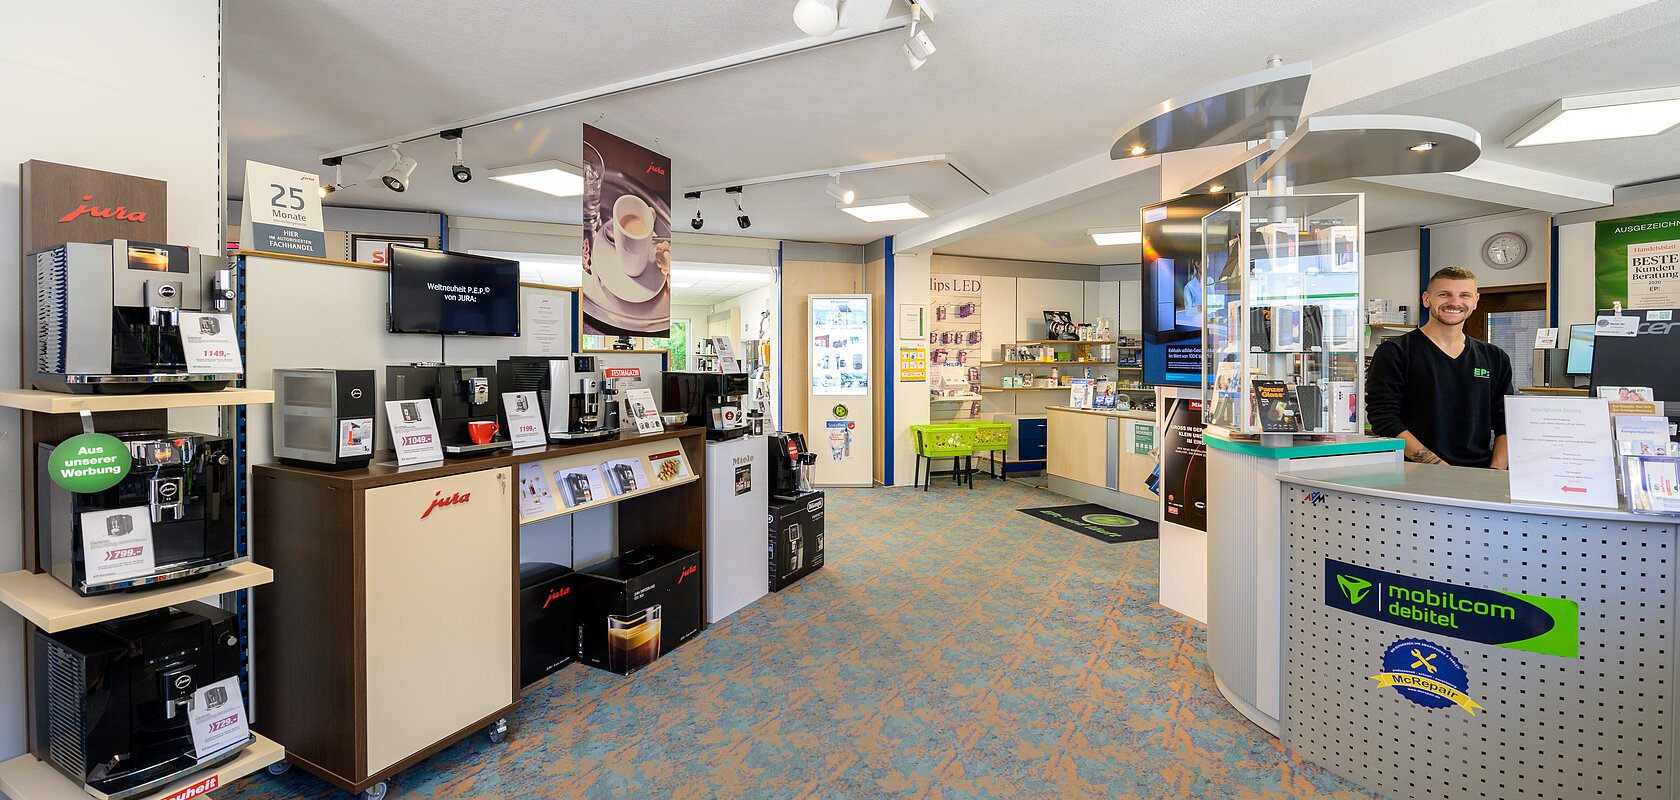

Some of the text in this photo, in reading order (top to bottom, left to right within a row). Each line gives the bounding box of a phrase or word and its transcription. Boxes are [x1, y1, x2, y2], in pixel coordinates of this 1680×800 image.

[646, 161, 665, 175] jura
[270, 184, 305, 210] 25
[58, 195, 148, 223] jura
[272, 209, 307, 222] Monate
[277, 236, 312, 245] AUTORISIERTEN
[283, 230, 299, 238] HIER
[269, 240, 314, 252] FACHHANDEL
[1633, 244, 1676, 253] Handelsblatt
[1632, 254, 1679, 267] BESTE
[1635, 264, 1675, 273] Kunden
[1632, 271, 1679, 281] Beratung
[427, 282, 467, 294] Weltneuheit
[952, 279, 981, 292] LED
[457, 294, 477, 303] JURA:
[1638, 322, 1680, 335] cer
[203, 350, 230, 358] 1149,-
[611, 369, 640, 377] TESTMAGAZIN
[1473, 367, 1490, 377] EP:
[520, 425, 537, 433] 1199,-
[77, 446, 104, 456] Aus
[64, 454, 117, 467] unserer
[732, 455, 755, 466] Miele
[60, 464, 121, 479] Werbung
[420, 490, 471, 519] jura
[677, 564, 697, 585] jura
[543, 586, 571, 609] jura
[1389, 585, 1516, 620] mobilcom
[1389, 601, 1459, 629] debitel
[1421, 642, 1446, 655] SMARTPHONE
[1391, 674, 1459, 698] McRepair
